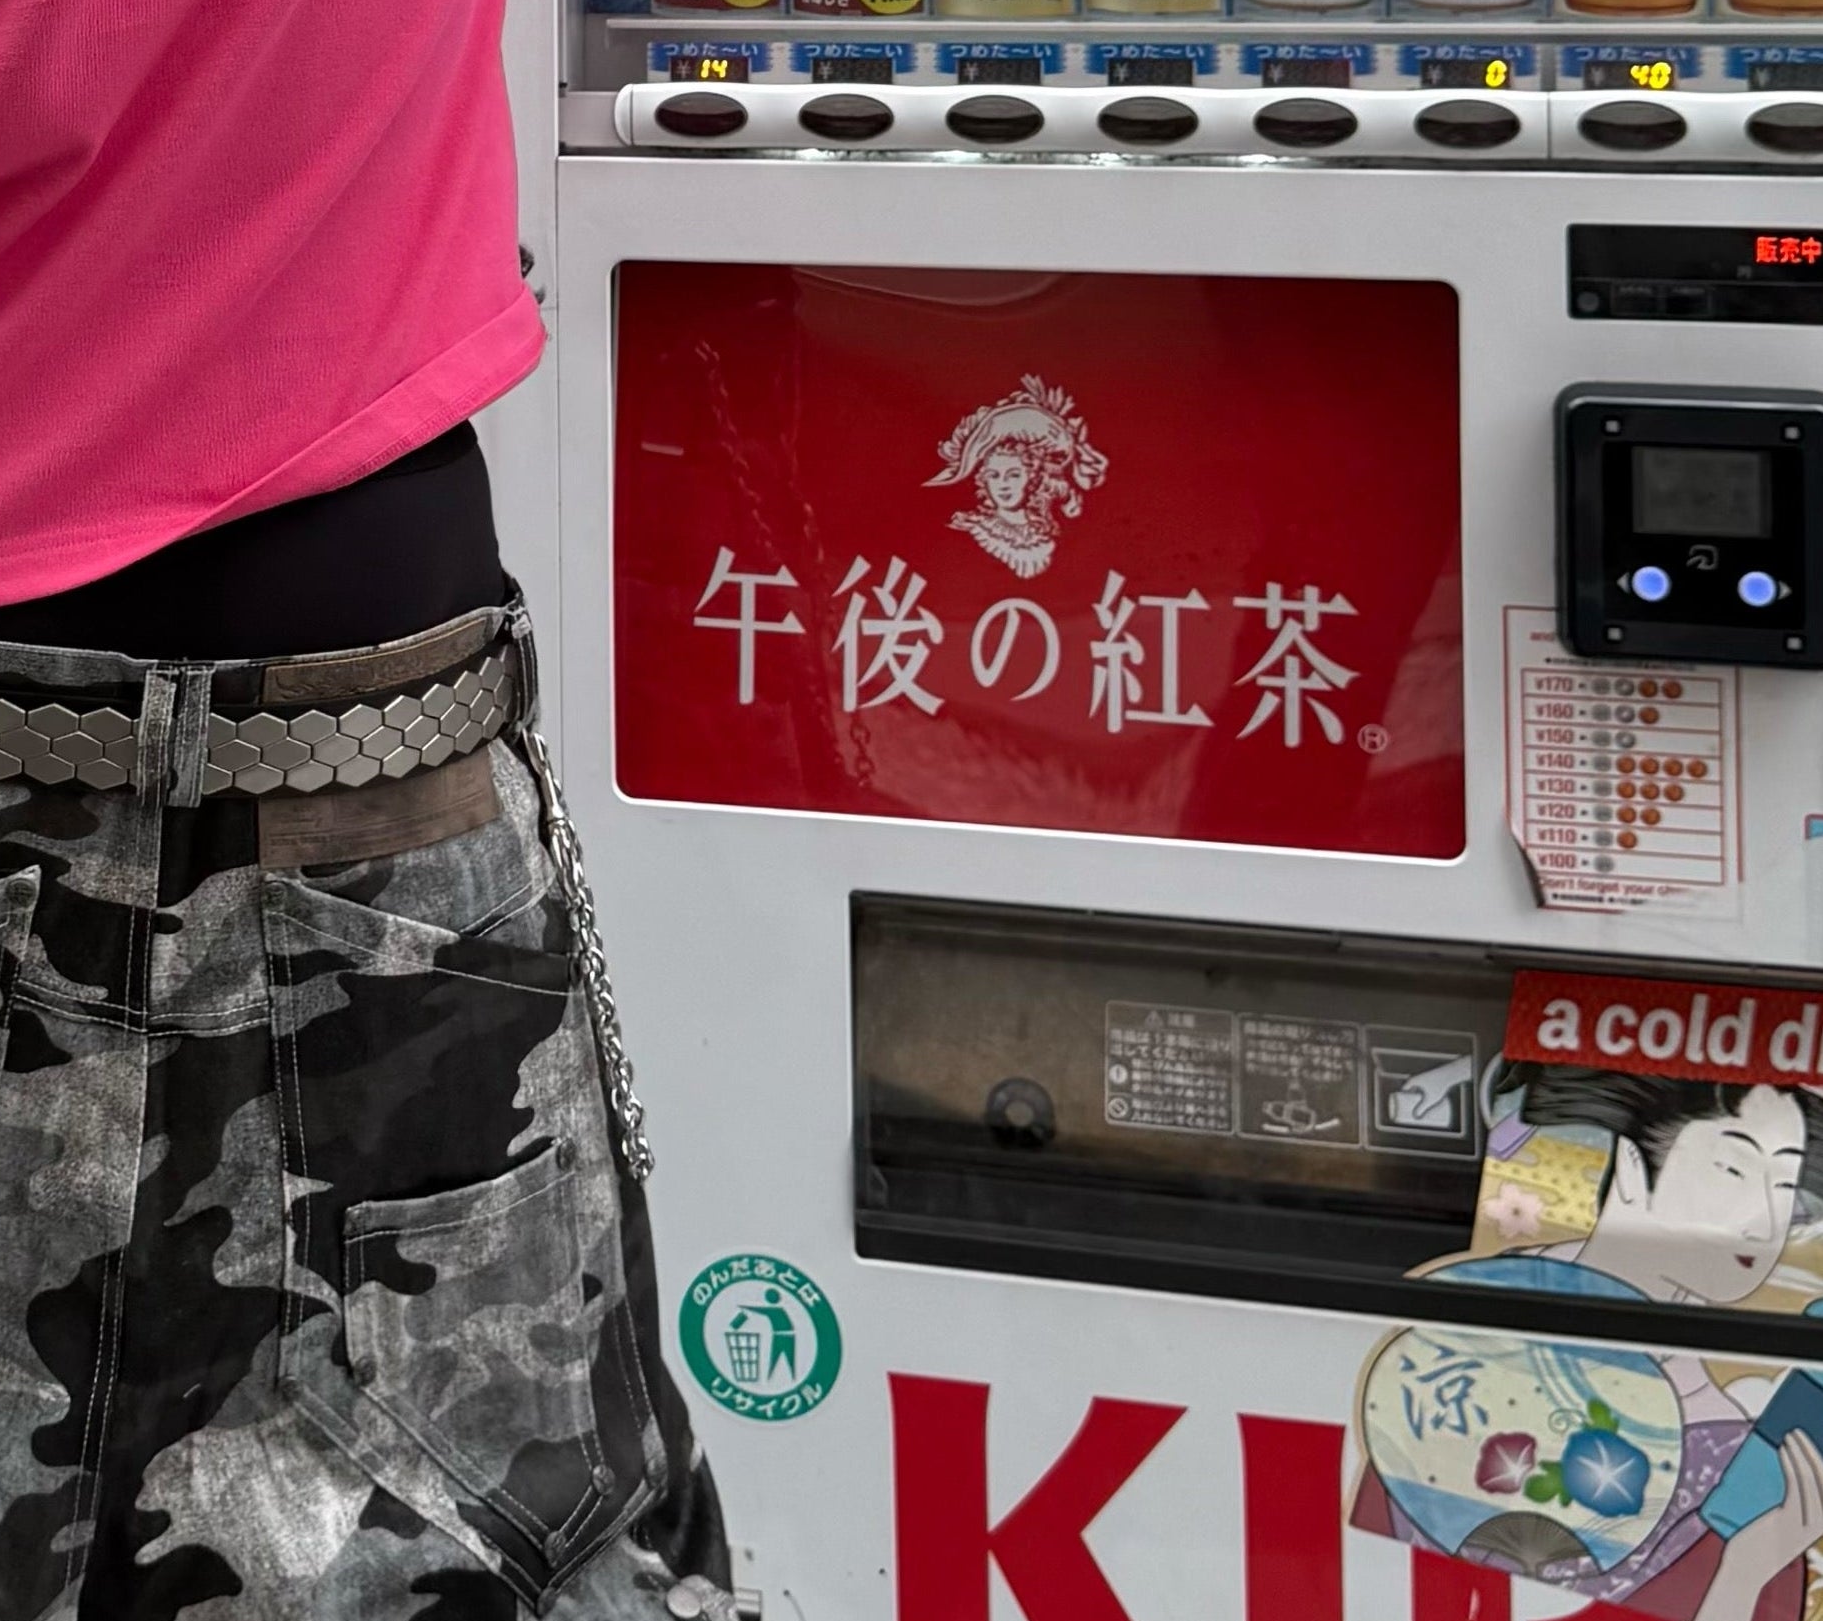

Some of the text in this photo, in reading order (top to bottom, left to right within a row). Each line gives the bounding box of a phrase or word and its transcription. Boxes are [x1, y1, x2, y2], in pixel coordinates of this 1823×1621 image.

[694, 546, 1359, 748] 午後の紅茶
[1538, 1010, 1584, 1051] a
[1596, 994, 1754, 1066] cold
